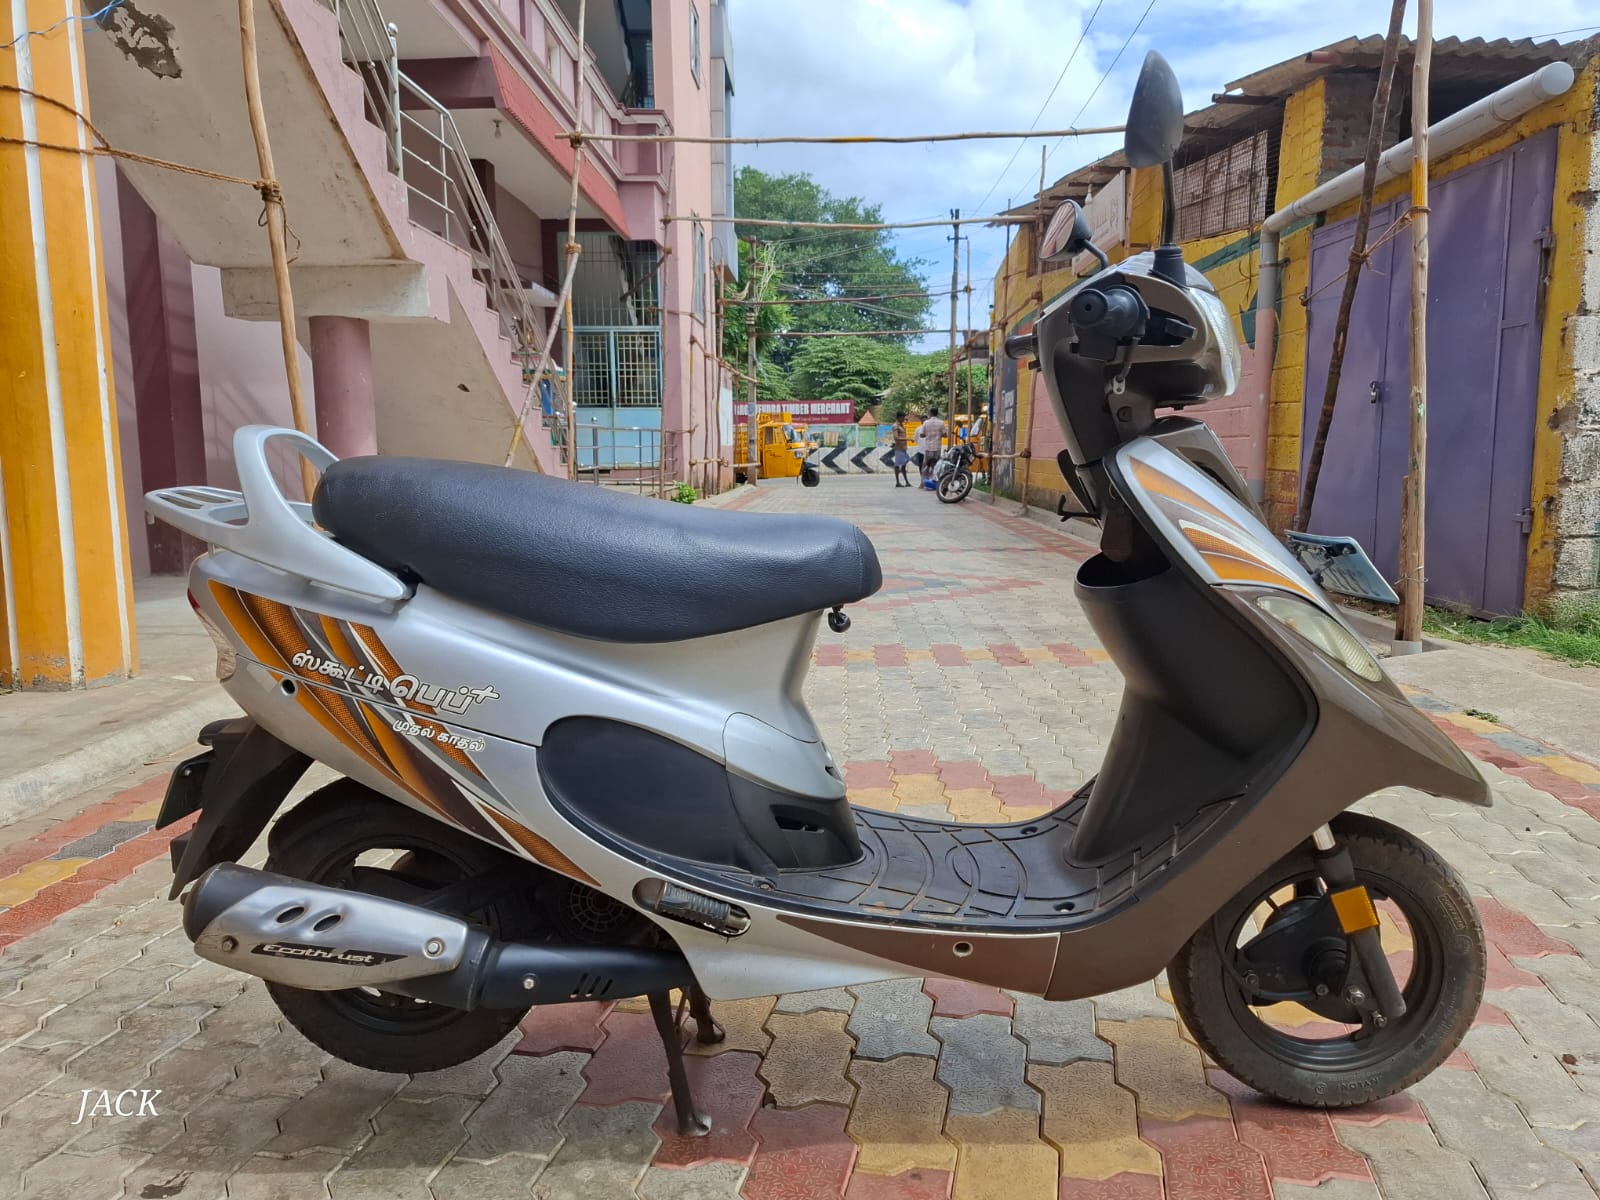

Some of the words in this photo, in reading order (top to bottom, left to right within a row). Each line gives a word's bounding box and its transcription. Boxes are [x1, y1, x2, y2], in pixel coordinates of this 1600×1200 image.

[782, 403, 809, 415] TIMBER
[810, 402, 851, 415] MERCHANT
[292, 650, 384, 693] ஸ்கூட்டி
[392, 718, 435, 739] முதல்
[436, 732, 485, 752] காதல்
